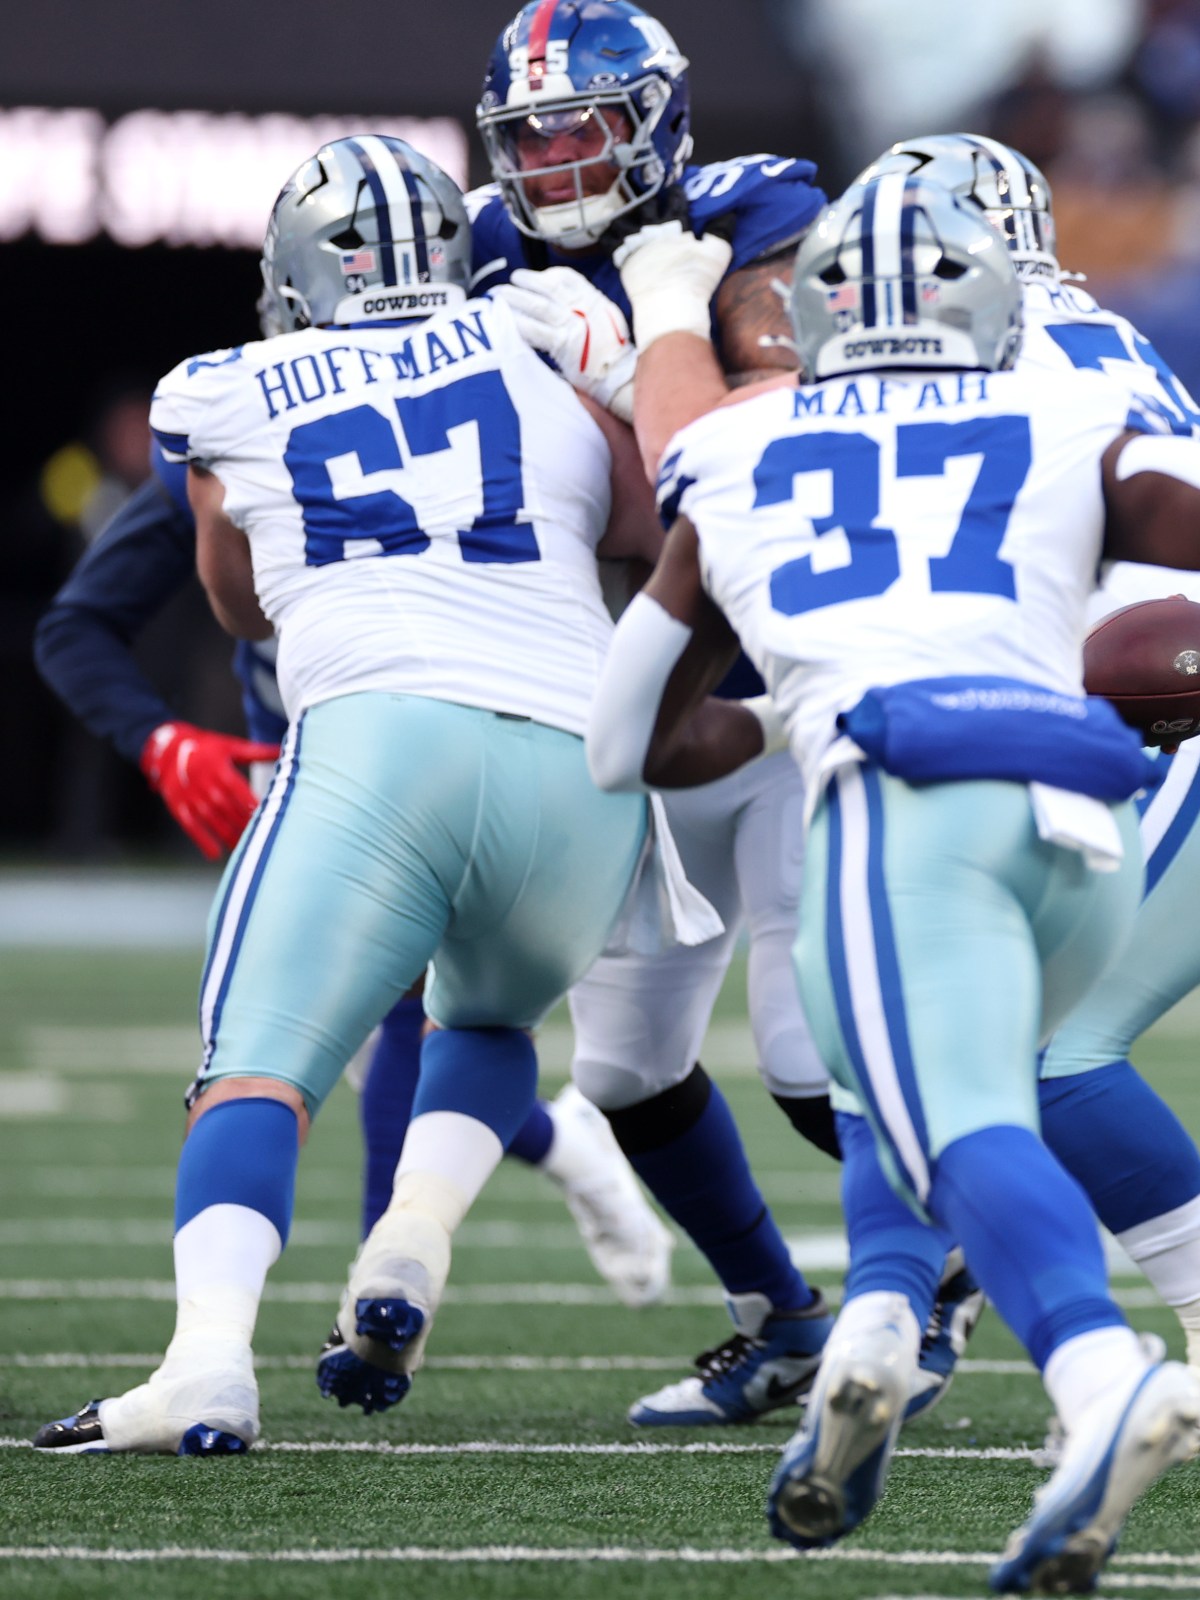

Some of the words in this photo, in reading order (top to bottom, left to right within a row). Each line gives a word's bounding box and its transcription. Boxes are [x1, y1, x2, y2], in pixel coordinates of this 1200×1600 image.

[363, 292, 447, 314] COWBOYS
[843, 337, 942, 359] COWBOYS
[255, 310, 494, 420] HOFFMAN
[283, 368, 542, 567] 67
[752, 414, 1032, 618] 37
